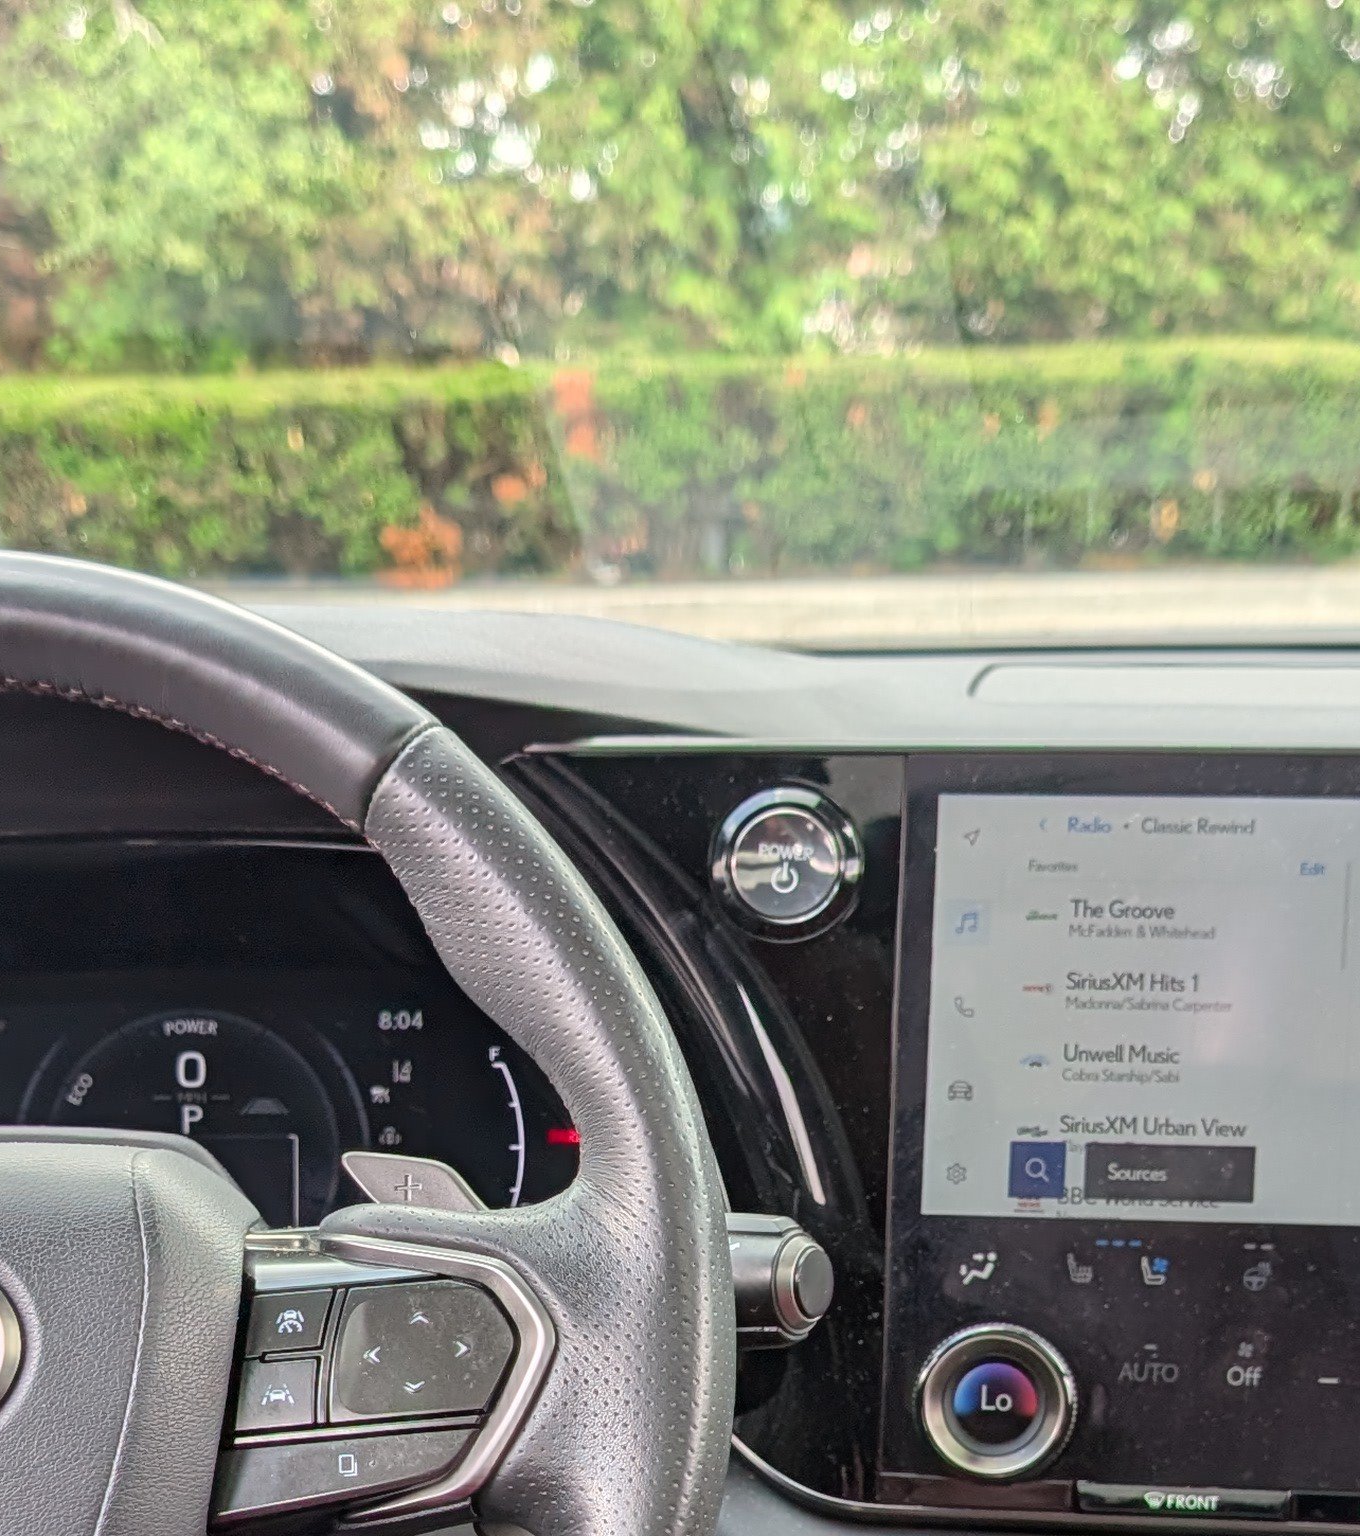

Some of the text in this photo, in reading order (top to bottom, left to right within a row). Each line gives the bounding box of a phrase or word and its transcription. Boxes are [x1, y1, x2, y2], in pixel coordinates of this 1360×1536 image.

[1067, 816, 1255, 835] Radio Classic Rewind
[758, 843, 814, 862] POWER
[1299, 863, 1325, 876] Edit
[1071, 899, 1104, 919] The
[1109, 900, 1175, 920] Groove
[1065, 971, 1144, 992] SiriusXM
[1150, 972, 1186, 993] Hits
[1191, 973, 1200, 993] 1
[162, 1018, 218, 1037] POWER
[377, 1010, 424, 1031] 8:04
[1063, 1043, 1180, 1065] Unwell Music
[176, 1051, 207, 1089] 0
[181, 1104, 204, 1135] P
[1060, 1114, 1138, 1136] SiriusXM
[1143, 1116, 1197, 1138] Urban
[1201, 1118, 1248, 1138] View
[1107, 1162, 1169, 1183] Sources
[1117, 1361, 1181, 1384] AUTO
[1226, 1364, 1264, 1388] Off
[980, 1384, 1014, 1413] Lo
[1166, 1493, 1220, 1512] FRONT
